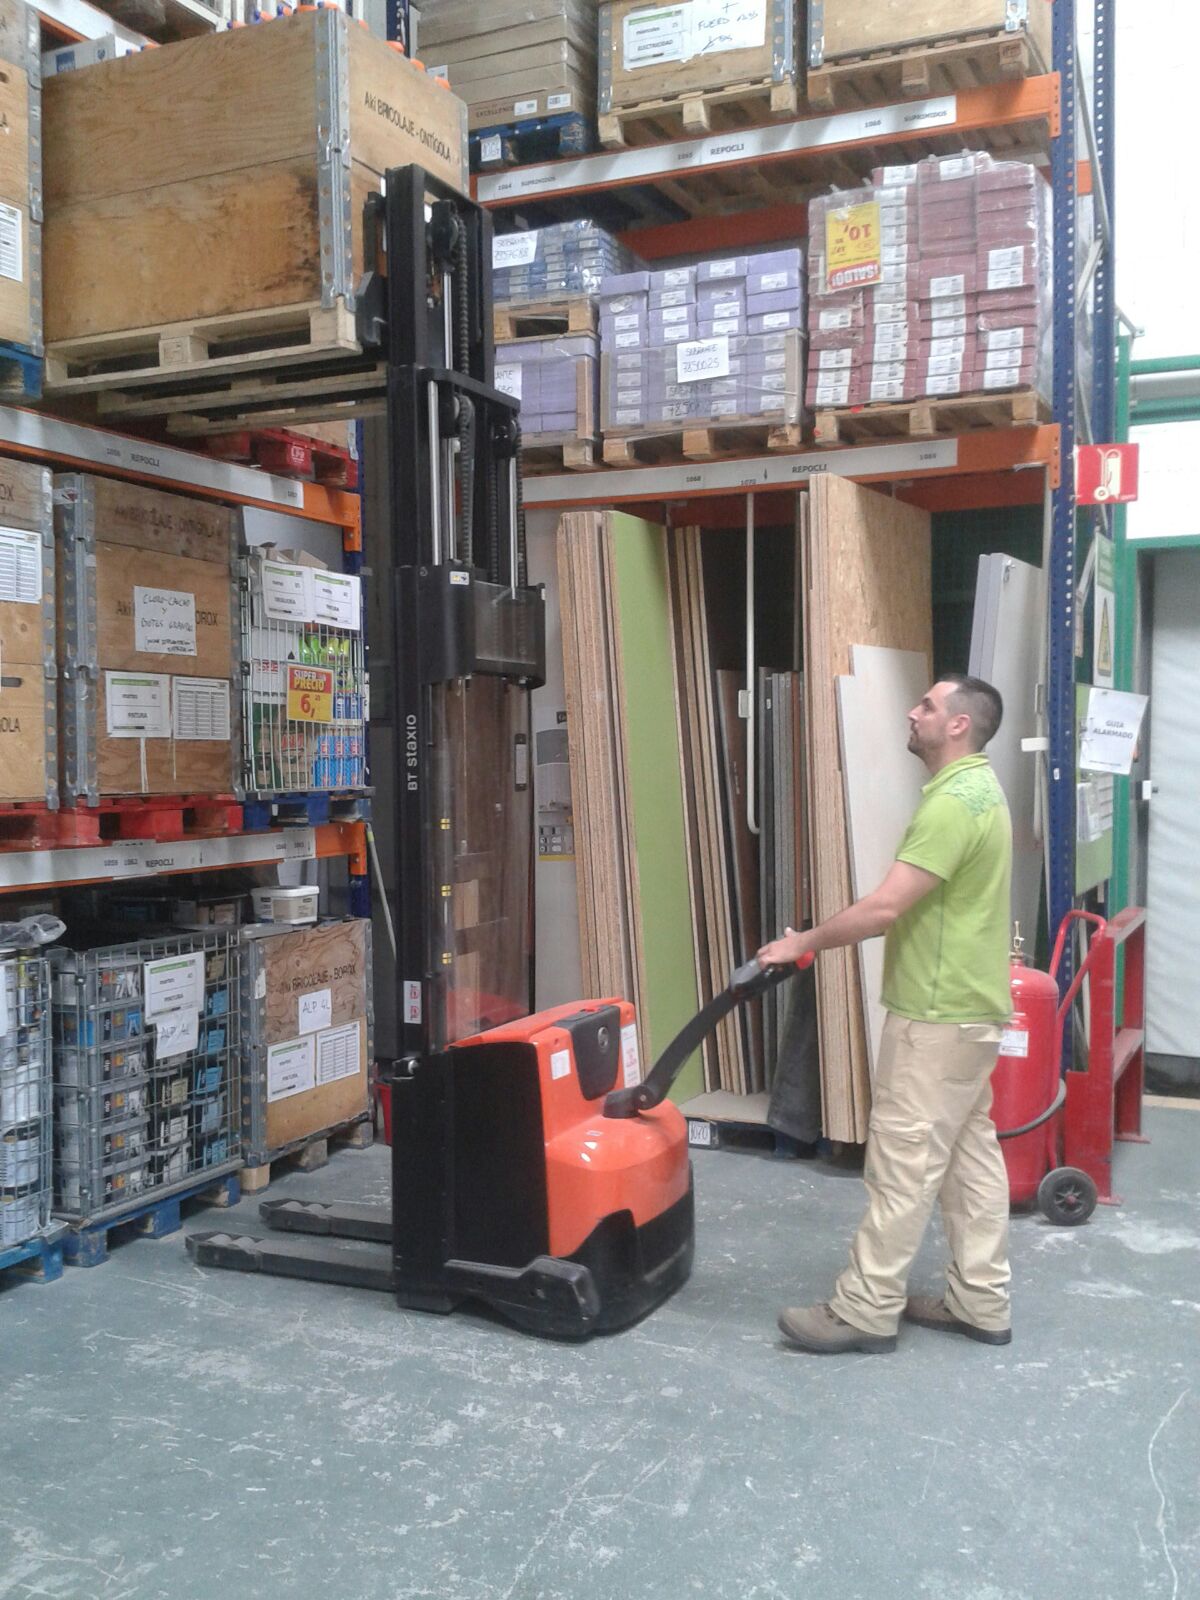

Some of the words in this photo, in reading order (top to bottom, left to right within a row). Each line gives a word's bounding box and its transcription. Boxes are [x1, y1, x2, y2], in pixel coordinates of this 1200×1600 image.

[377, 98, 415, 137] BRICOLAJE
[710, 143, 745, 156] REPOCLI
[130, 452, 160, 467] REPOCLI
[791, 463, 828, 474] REPOCLI
[293, 670, 317, 680] SUPER
[293, 678, 326, 692] PRECIO
[1093, 727, 1134, 740] ALARMADO
[407, 772, 418, 791] BT
[145, 857, 175, 868] REPOCLI
[302, 1000, 318, 1014] ALP
